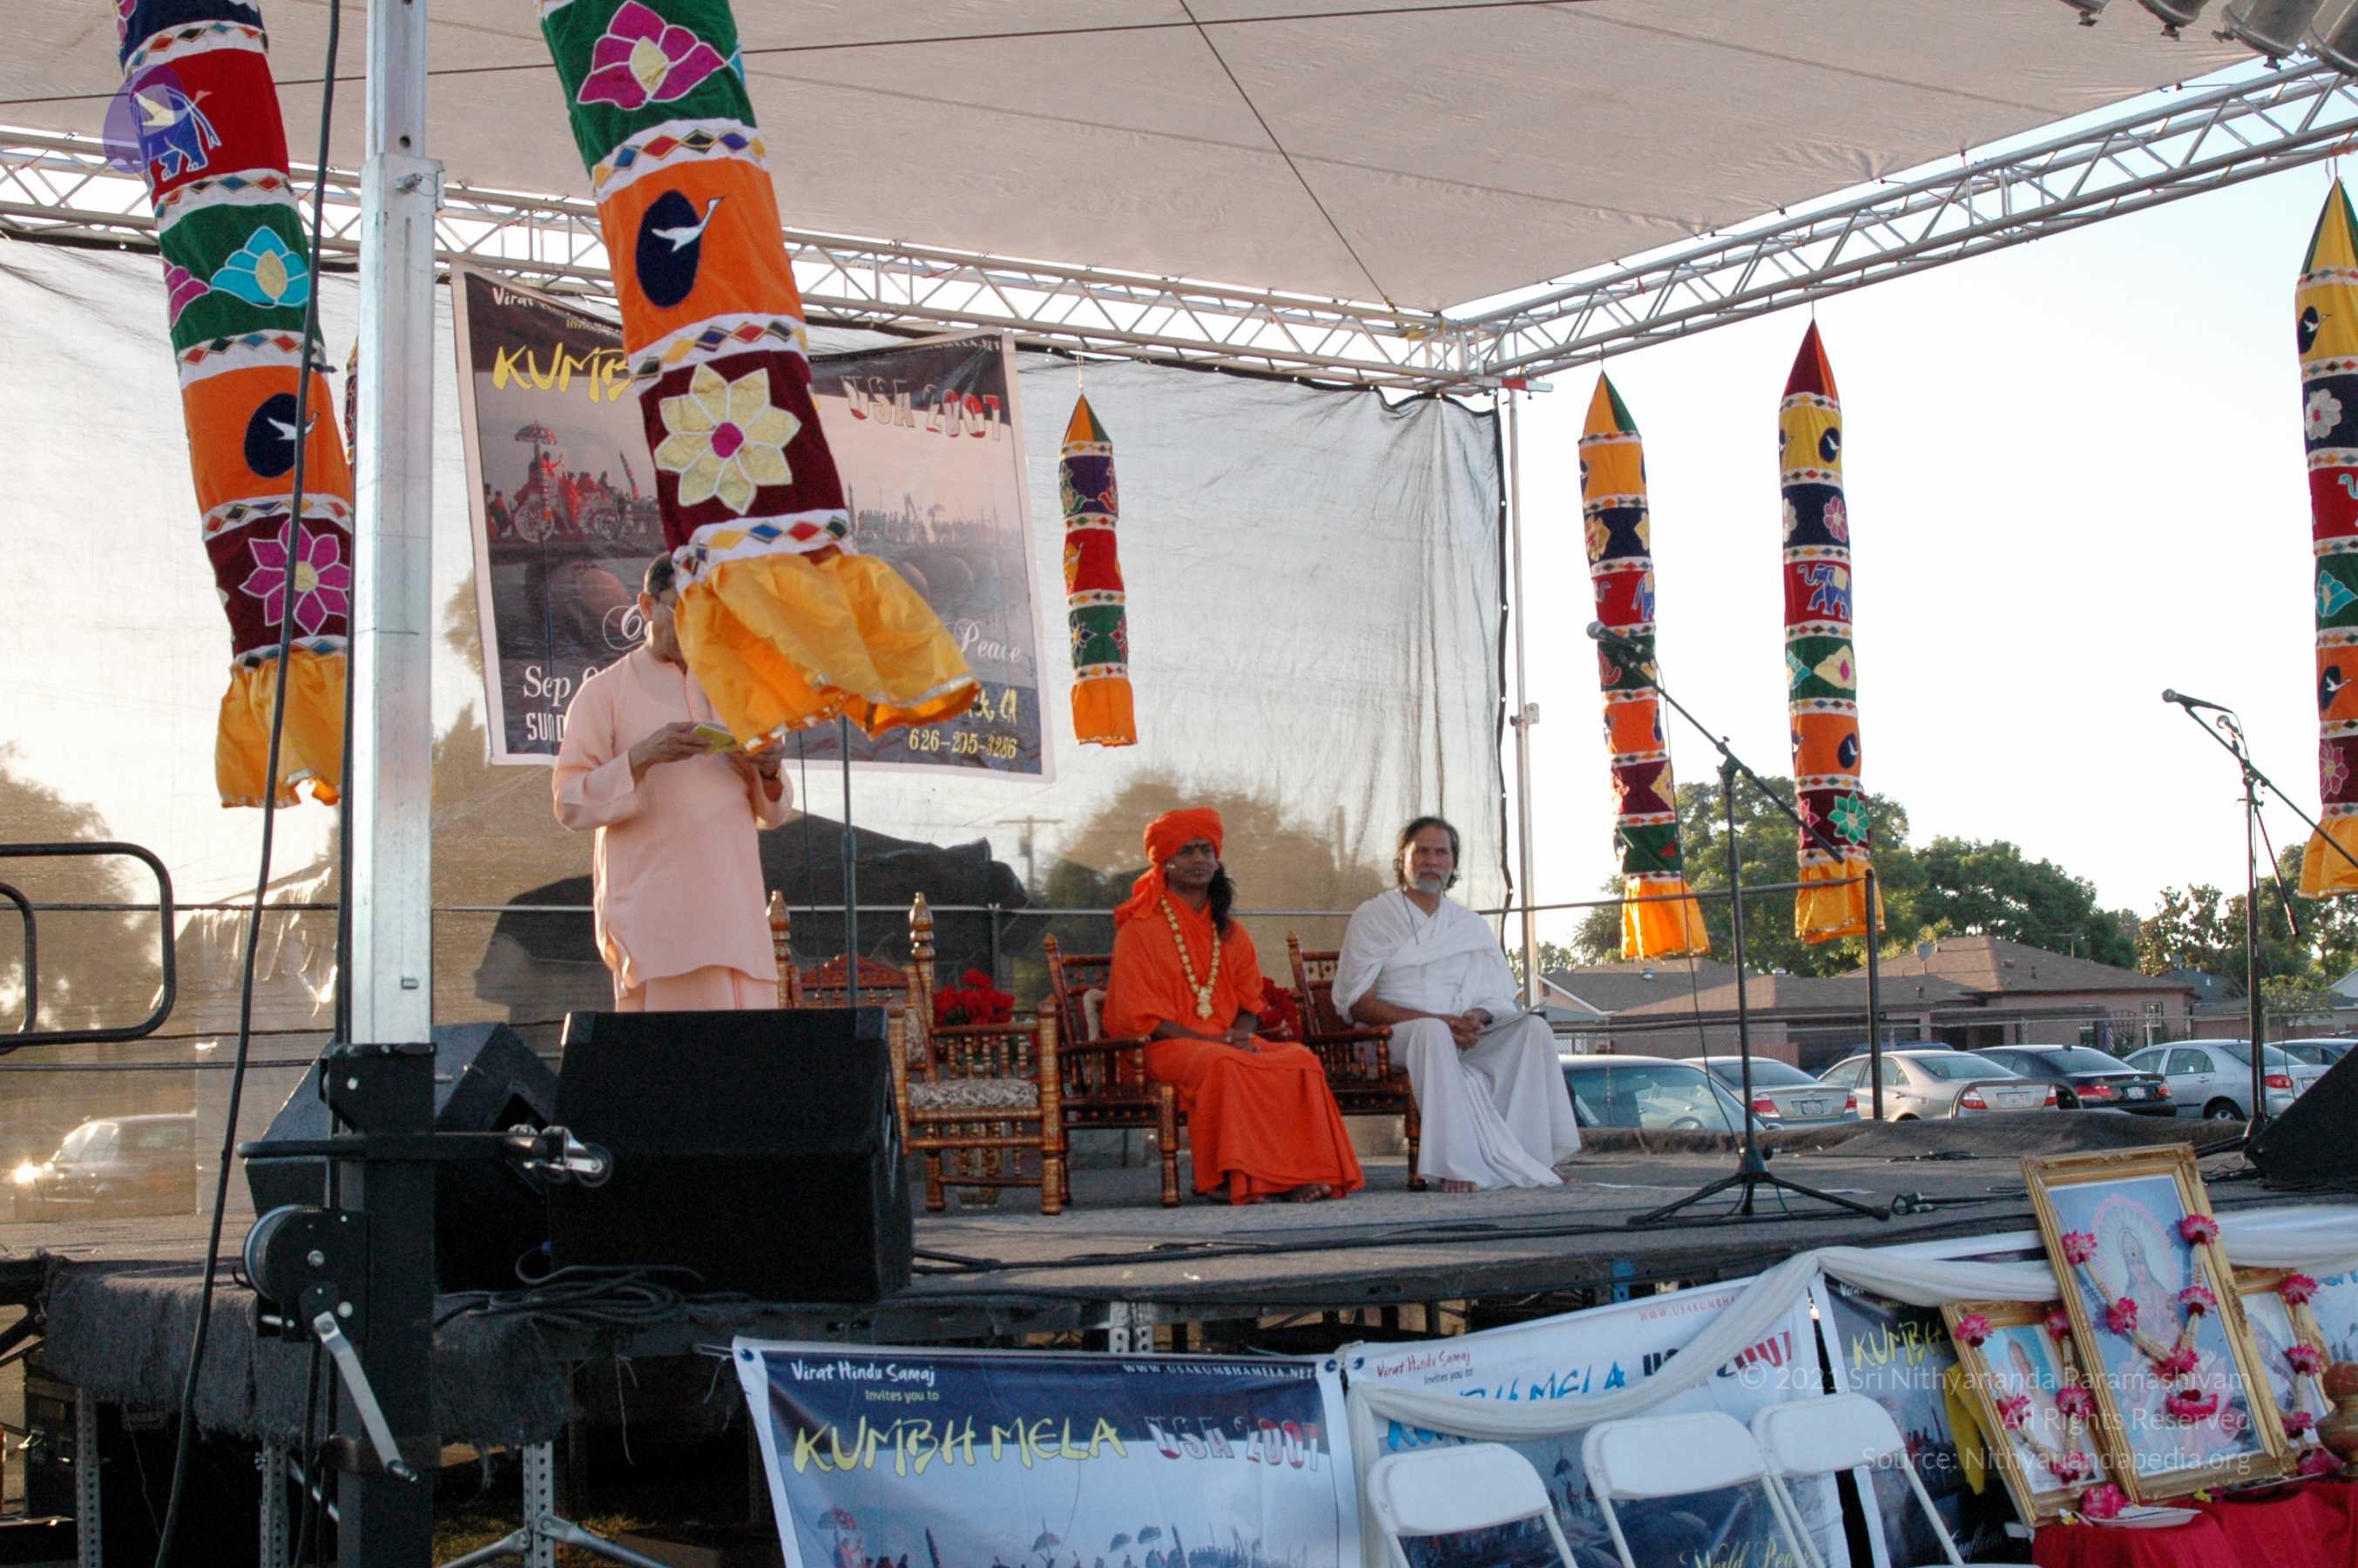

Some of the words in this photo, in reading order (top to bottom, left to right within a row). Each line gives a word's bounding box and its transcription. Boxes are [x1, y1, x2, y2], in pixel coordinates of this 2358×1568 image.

[493, 341, 632, 402] KUMB
[840, 375, 915, 428] USA
[524, 666, 571, 707] Sep
[526, 712, 565, 742] SUND
[791, 1360, 834, 1381] Virat
[838, 1361, 883, 1381] Hindu
[886, 1364, 936, 1387] Samaj
[865, 1389, 902, 1402] Invites
[905, 1391, 924, 1403] you
[927, 1391, 940, 1401] to
[794, 1415, 976, 1477] KUMBH
[991, 1416, 1128, 1470] MELA
[1145, 1416, 1234, 1460] USA
[1234, 1416, 1321, 1472] 2007
